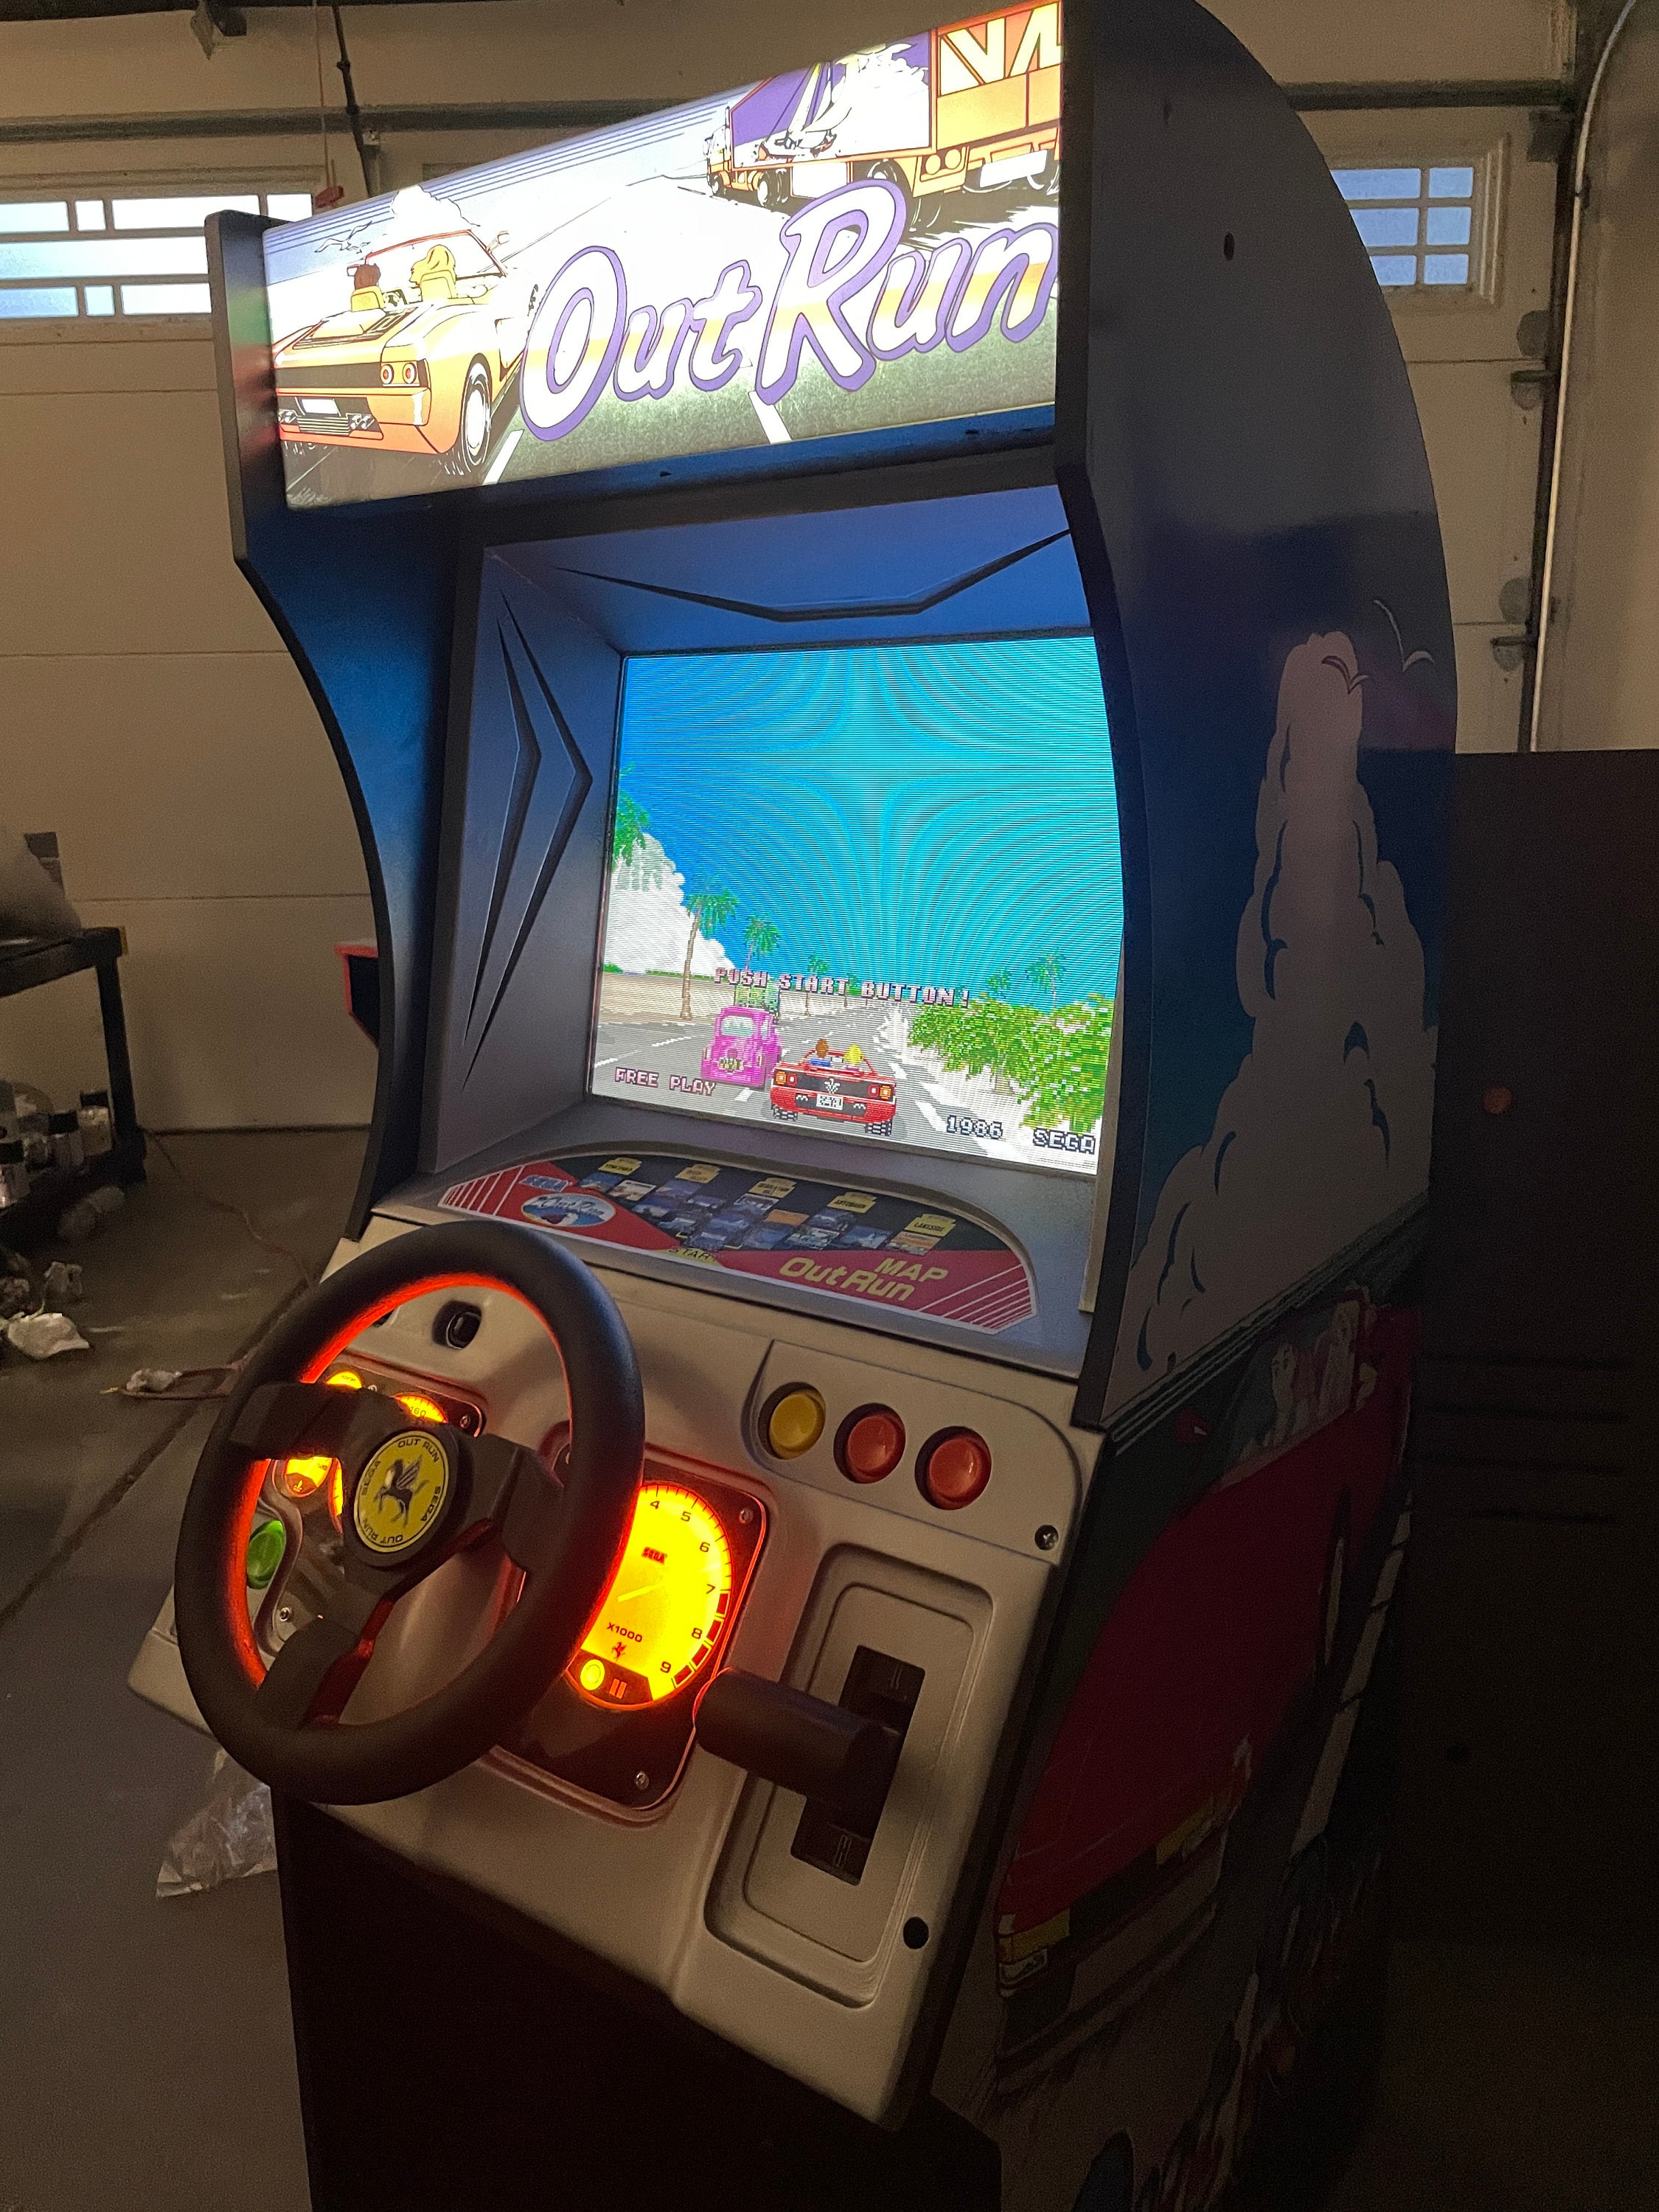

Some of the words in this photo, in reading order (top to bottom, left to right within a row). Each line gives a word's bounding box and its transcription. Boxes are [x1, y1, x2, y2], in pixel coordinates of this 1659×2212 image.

[714, 968, 768, 987] PUSH
[779, 974, 849, 995] START
[861, 981, 970, 1007] BUTTON!
[615, 1067, 659, 1088] FREE
[669, 1074, 717, 1096] PLAY
[947, 1115, 1003, 1139] 1986
[1033, 1128, 1096, 1155] SEGA
[874, 1258, 949, 1282] MAP
[397, 1439, 420, 1448] OUT
[422, 1440, 440, 1463] RUN
[420, 1486, 441, 1522] SEGA
[650, 1500, 661, 1510] 4
[681, 1511, 692, 1522] 5
[363, 1520, 378, 1541] RUN
[380, 1534, 403, 1544] OUT
[641, 1546, 667, 1565] SEGA
[699, 1542, 710, 1553] 6
[706, 1584, 716, 1595] 7
[607, 1622, 643, 1643] X1000
[692, 1627, 703, 1639] 8
[660, 1661, 671, 1673] 9
